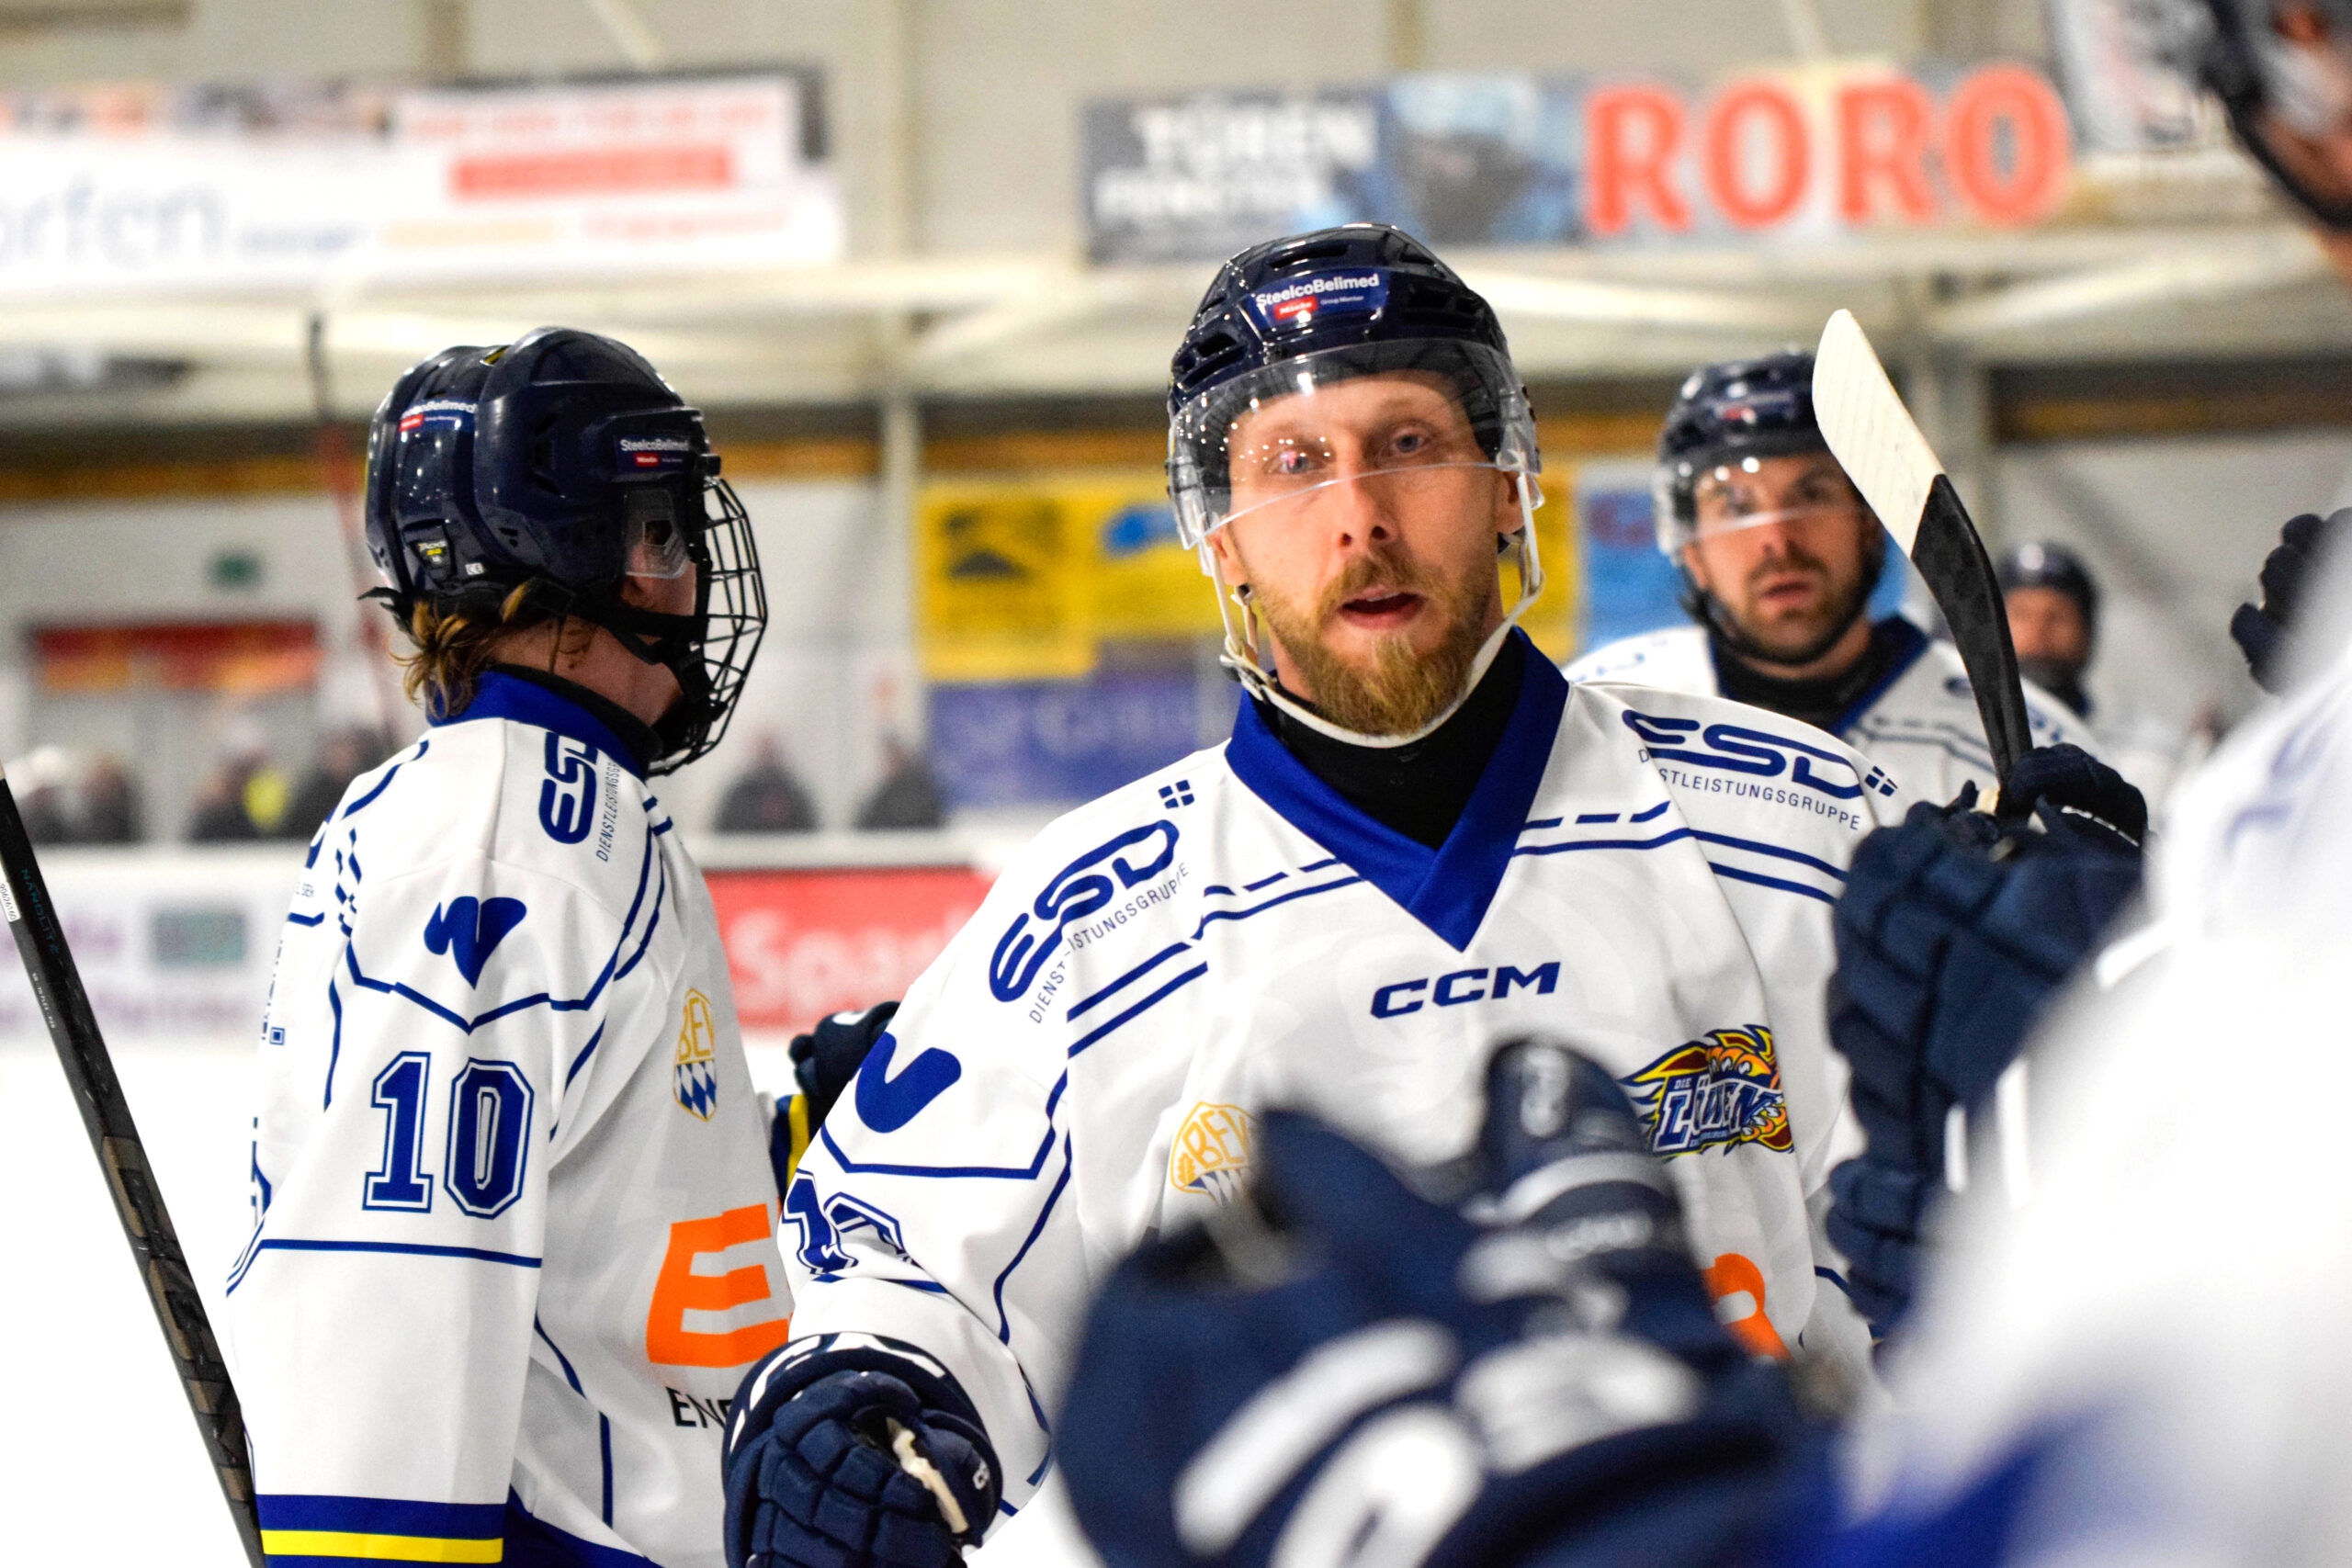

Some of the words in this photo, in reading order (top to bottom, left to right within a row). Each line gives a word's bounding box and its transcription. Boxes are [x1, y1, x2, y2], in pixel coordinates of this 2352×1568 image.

[1588, 66, 2073, 235] RORO
[1255, 273, 1380, 306] SteelcoBelimed
[1622, 709, 1864, 800] ESD
[1638, 748, 1860, 830] DSTLEISTUNGSGRUPPE
[989, 819, 1180, 1002] ESD
[1029, 863, 1189, 1024] DIENSTISTUNGSGRUPE
[1370, 962, 1561, 1020] CCM
[1674, 1077, 1692, 1089] DIE
[362, 1051, 534, 1220] 10
[665, 1385, 732, 1428] EN
